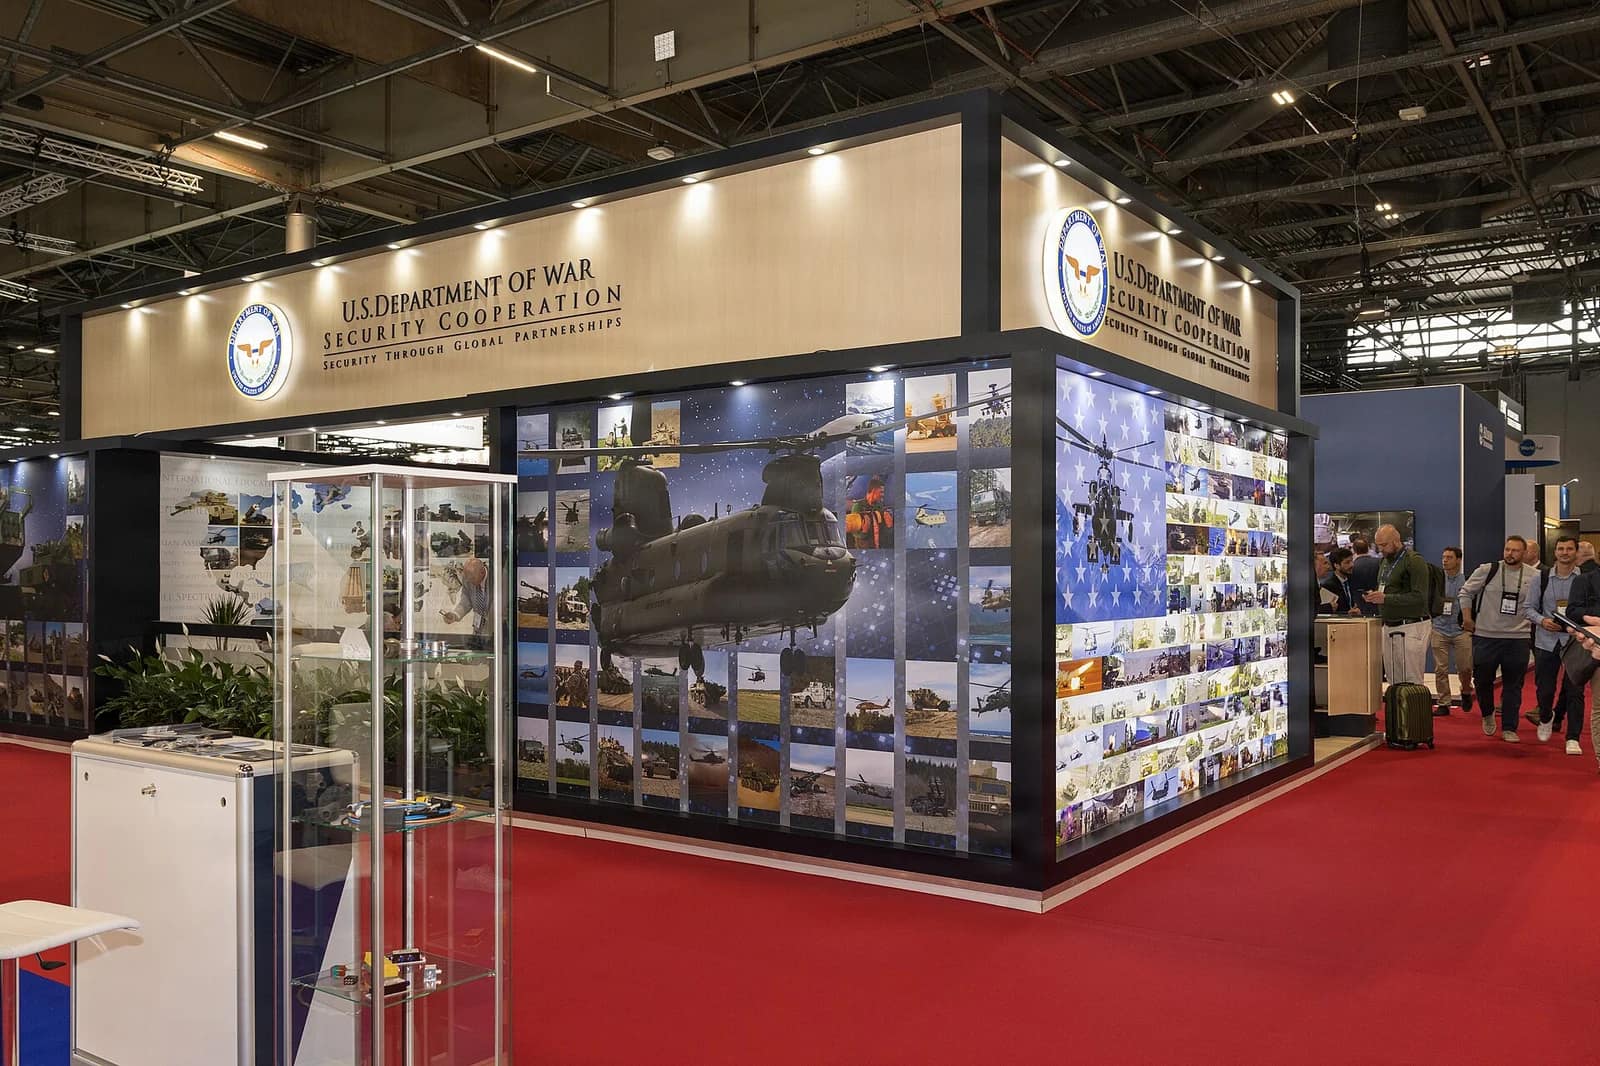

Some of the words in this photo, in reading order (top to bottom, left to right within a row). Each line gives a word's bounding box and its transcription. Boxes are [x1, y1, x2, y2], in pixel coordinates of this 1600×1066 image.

[1059, 211, 1091, 250] DEPARTMENT
[1091, 223, 1100, 237] OF
[1099, 241, 1107, 270] WAR
[508, 268, 536, 293] OF
[542, 258, 595, 287] WAR
[230, 305, 262, 345] DEPARTMENT
[263, 308, 273, 318] OF
[271, 316, 281, 337] WAR
[323, 319, 425, 350] SECURITY
[439, 284, 622, 331] COOPERATION
[1061, 287, 1073, 320] UNITED
[1109, 284, 1168, 327] ECURITY
[1174, 314, 1250, 363] COOPERATION
[1207, 304, 1220, 326] OF
[1221, 310, 1242, 337] WAR
[323, 355, 377, 371] SECURITY
[385, 344, 444, 361] THROUGH
[454, 336, 504, 351] GLOBAL
[515, 317, 621, 342] PARTNERSHIPS
[1104, 315, 1139, 338] ECURITY
[1143, 330, 1178, 354] THROUGH
[1182, 347, 1206, 365] GLOBAL
[1210, 358, 1250, 383] PARTNERSHIPS
[231, 369, 244, 390] UNITED
